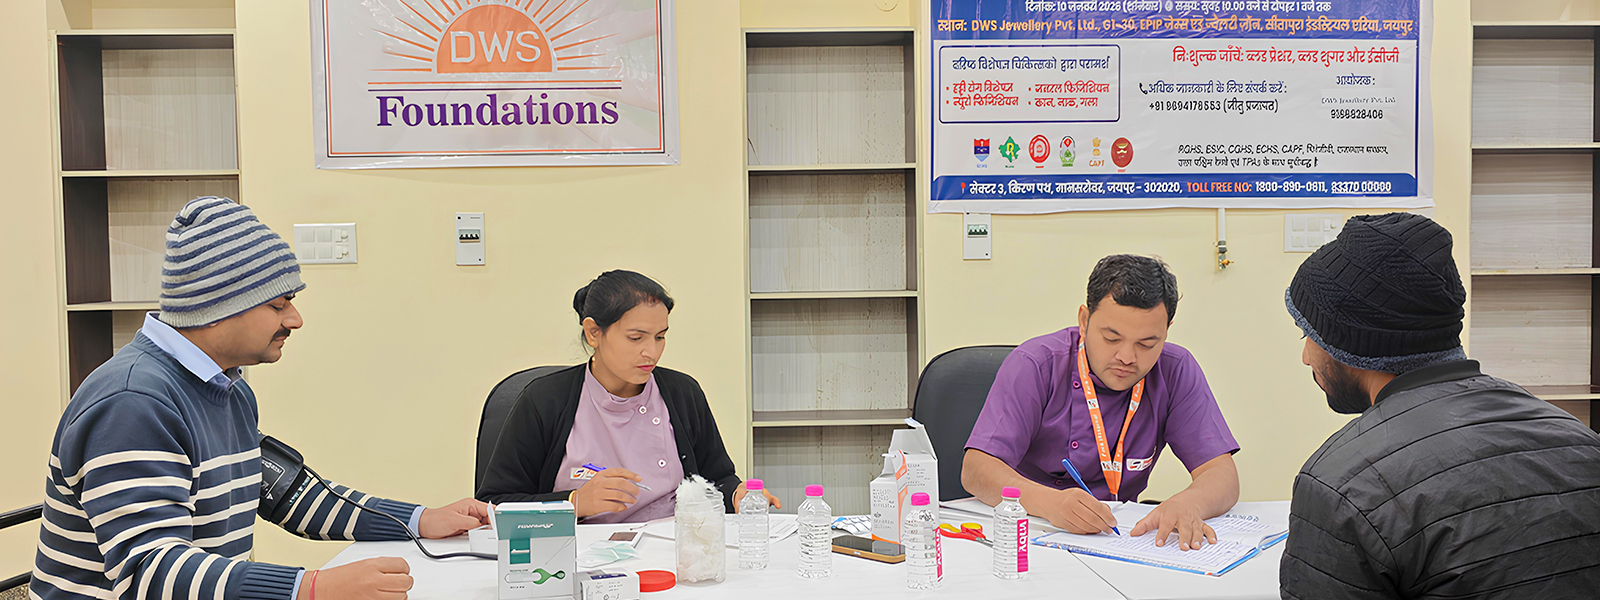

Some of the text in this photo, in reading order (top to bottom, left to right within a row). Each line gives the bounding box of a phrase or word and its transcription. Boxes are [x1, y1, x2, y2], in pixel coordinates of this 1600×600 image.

[1057, 1, 1067, 11] 10
[937, 19, 967, 31] स्थान:
[971, 19, 998, 31] DWS
[999, 19, 1053, 35] Jewellery
[1055, 19, 1076, 31] Pvt.
[1140, 19, 1163, 31] EPIP
[1382, 19, 1414, 36] जयपुर
[450, 31, 541, 63] DWS
[1367, 46, 1400, 63] ईसीजी
[1215, 80, 1225, 93] के
[375, 92, 620, 127] Foundations
[969, 180, 997, 194] सेक्टर
[997, 183, 1007, 195] 3,
[1143, 181, 1183, 194] 302020,
[1187, 181, 1210, 193] TOLL
[1210, 181, 1233, 193] FREE
[1234, 181, 1253, 193] NO:
